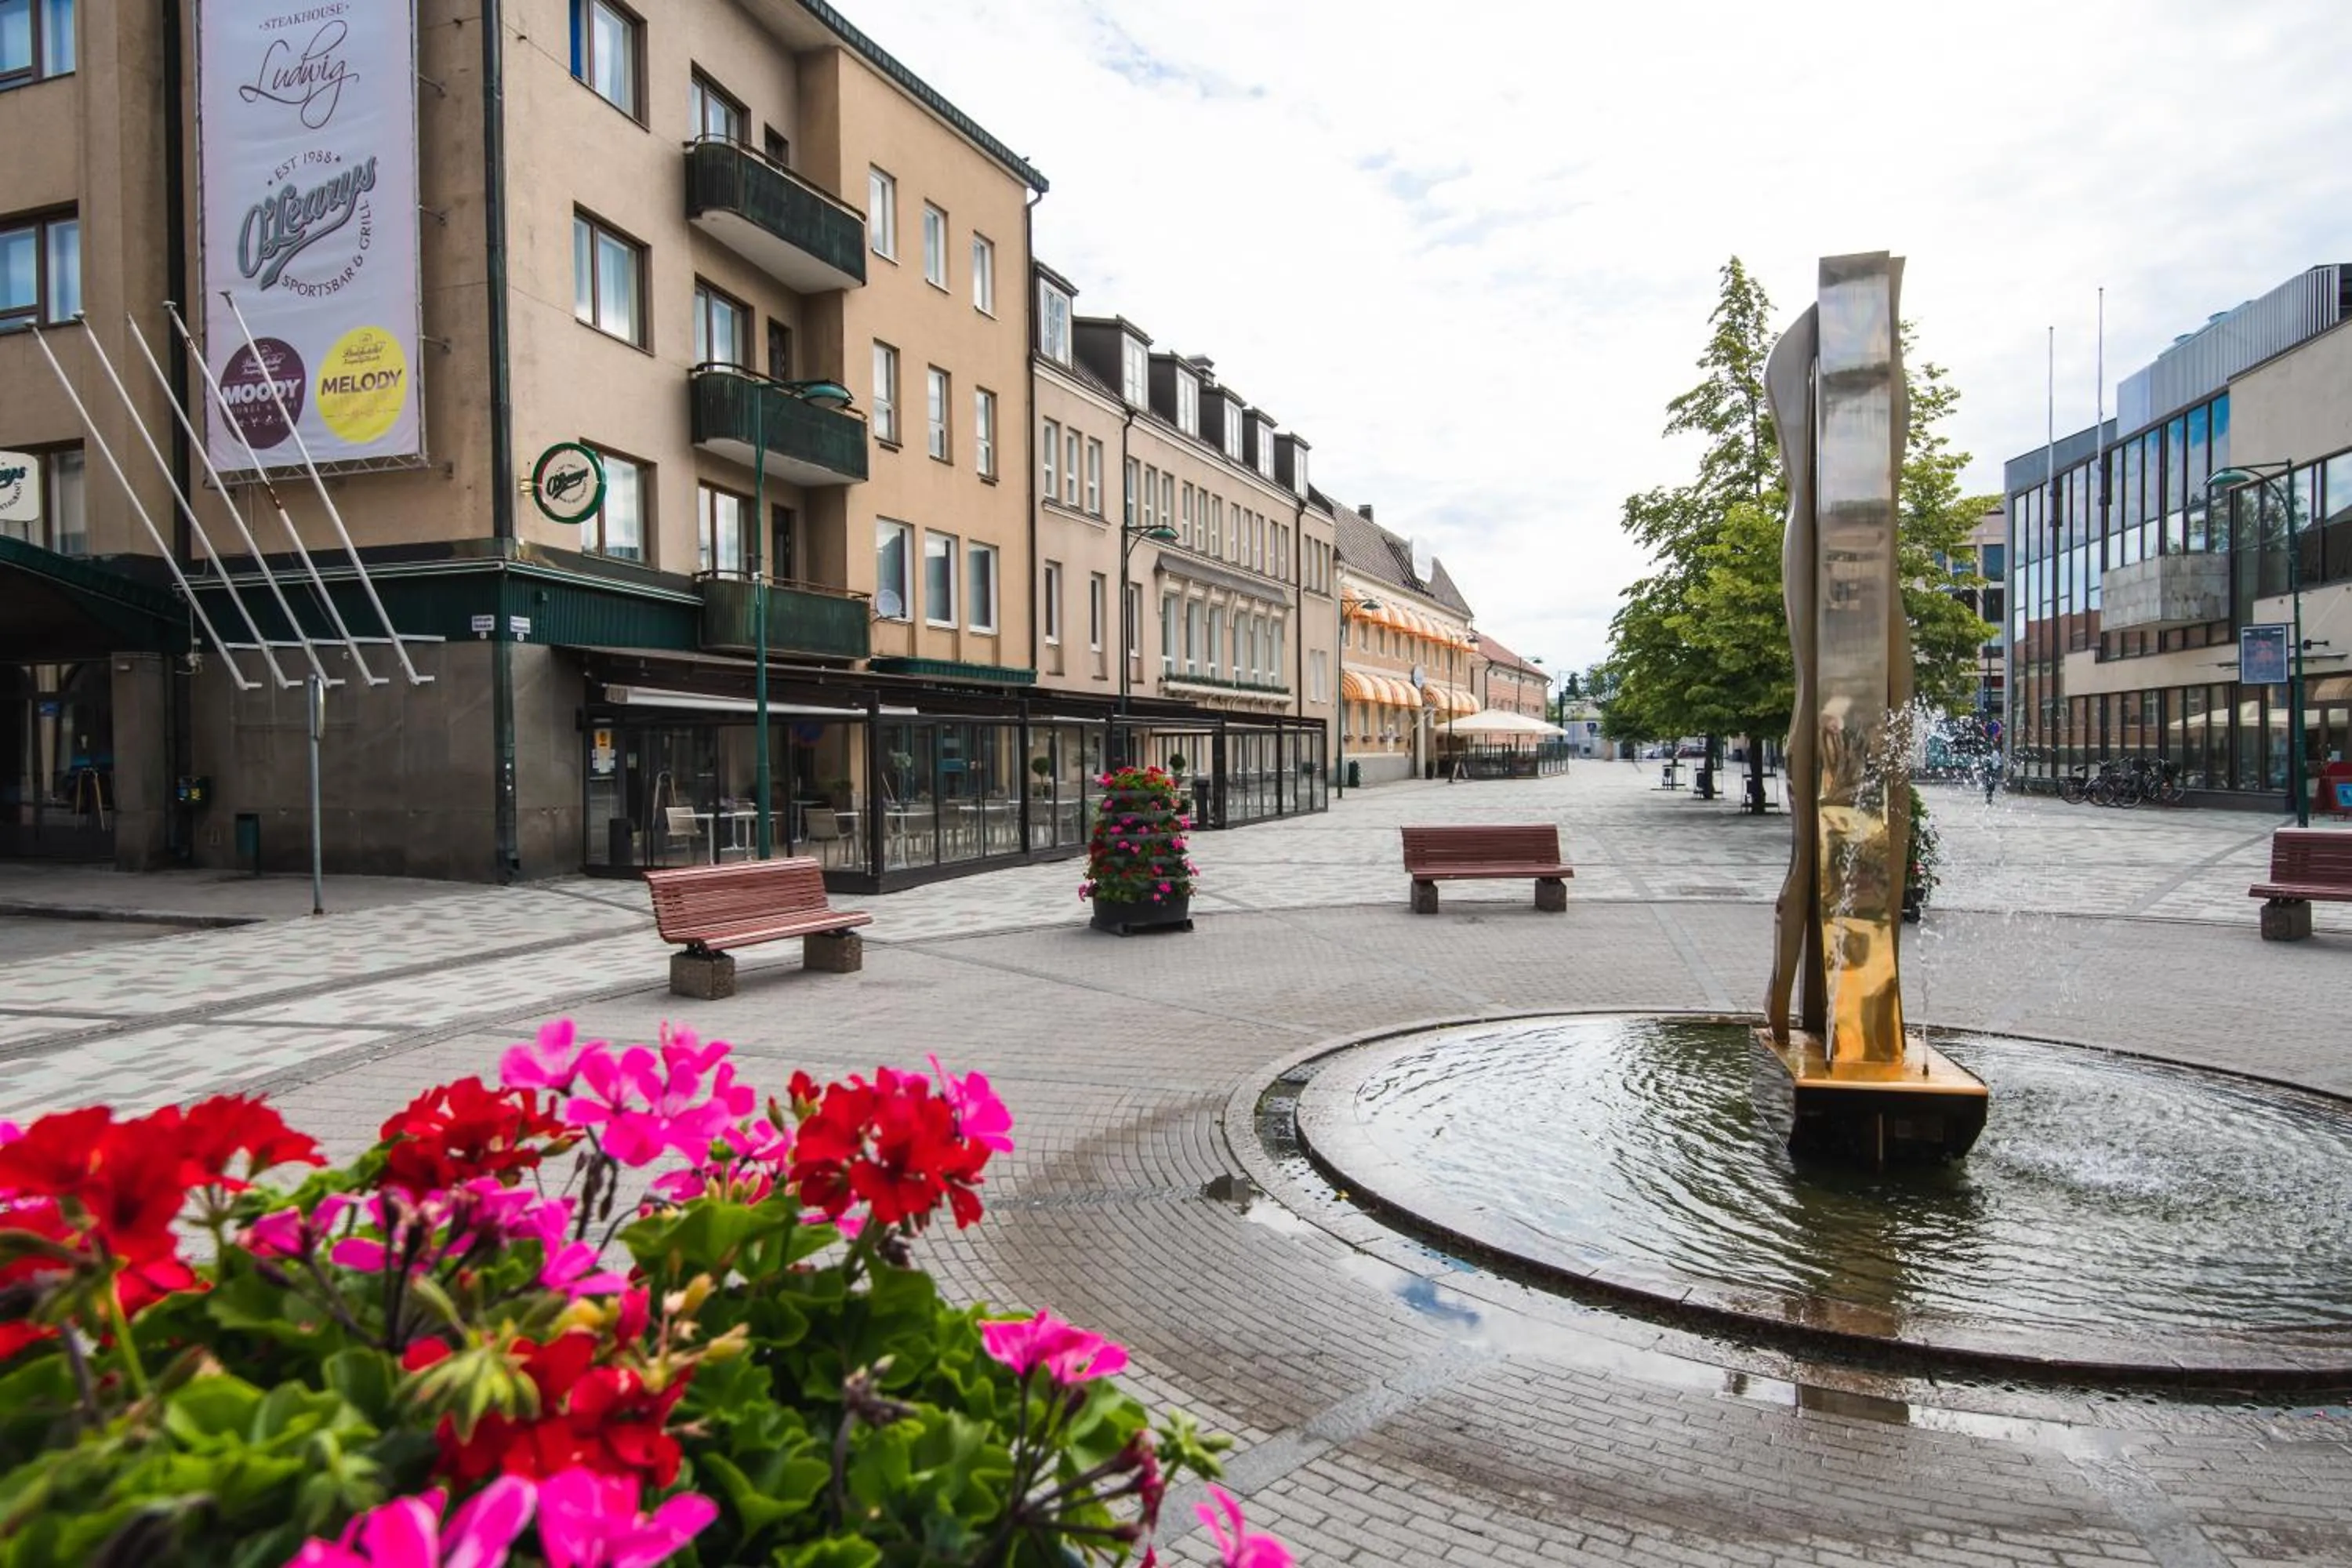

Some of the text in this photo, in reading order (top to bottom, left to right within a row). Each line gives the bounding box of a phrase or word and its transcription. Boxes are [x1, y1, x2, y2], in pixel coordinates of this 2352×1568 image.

[264, 3, 343, 31] STEAKHOUSE
[239, 20, 359, 129] Ludwig
[275, 150, 332, 180] EST 1988
[281, 267, 354, 297] SPORTSBAR
[358, 200, 372, 250] GRILL
[321, 368, 402, 396] MELODY
